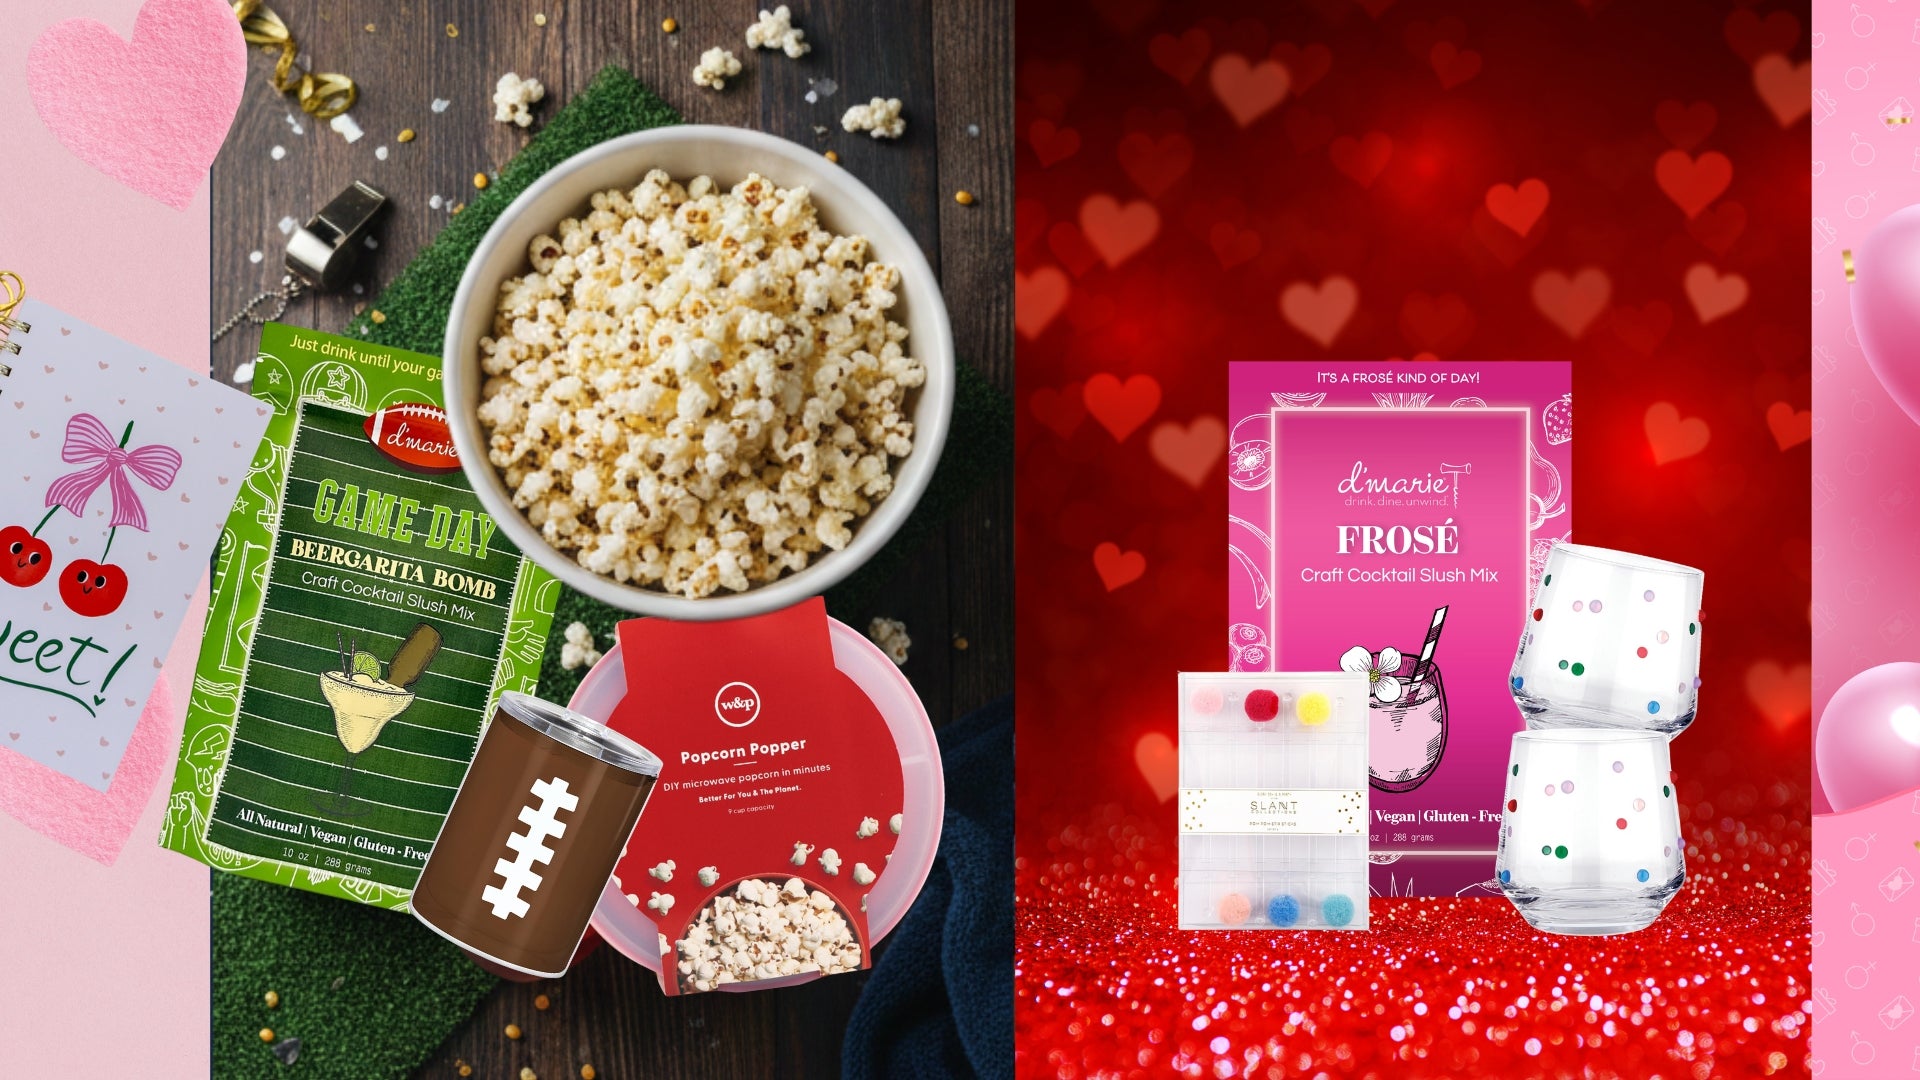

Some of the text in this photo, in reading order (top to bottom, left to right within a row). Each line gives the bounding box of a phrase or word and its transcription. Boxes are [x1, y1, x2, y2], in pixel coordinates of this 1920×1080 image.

[290, 334, 444, 382] Just drink until your ga
[1340, 373, 1350, 383] A
[1352, 370, 1393, 384] FROSÉ
[1397, 373, 1427, 383] KIND
[1430, 373, 1447, 383] OF
[1451, 371, 1480, 384] DAY!
[1337, 460, 1449, 494] d'marie
[1344, 495, 1376, 506] drink.
[312, 478, 497, 559] GAME DAY
[1336, 517, 1459, 555] FROSÉ
[290, 538, 497, 600] BEERGARITA BOMB
[1300, 567, 1498, 583] Craft Cocktail Slush Mix
[302, 571, 476, 622] Craft Cocktail Slush Mix
[0, 620, 138, 707] eet!
[721, 696, 755, 712] w&p
[681, 739, 807, 765] Popcorn Popper
[663, 764, 831, 792] DIY microwave popcorn in minutes
[699, 794, 722, 803] Better
[723, 793, 736, 801] For
[737, 791, 752, 799] You
[760, 788, 774, 796] The
[746, 804, 775, 813] capacity
[1250, 800, 1298, 810] SLANT
[236, 807, 254, 823] All
[254, 813, 303, 835] Natural
[310, 826, 347, 845] Vegan
[354, 835, 395, 855] Gluten
[1375, 809, 1416, 826] Vegan
[1424, 809, 1470, 822] Gluten
[1479, 809, 1503, 823] Fre
[1392, 833, 1407, 842] 288
[1411, 835, 1434, 843] grams
[283, 847, 294, 858] 10
[298, 851, 309, 861] oz
[324, 856, 341, 868] 288
[345, 862, 372, 876] grams
